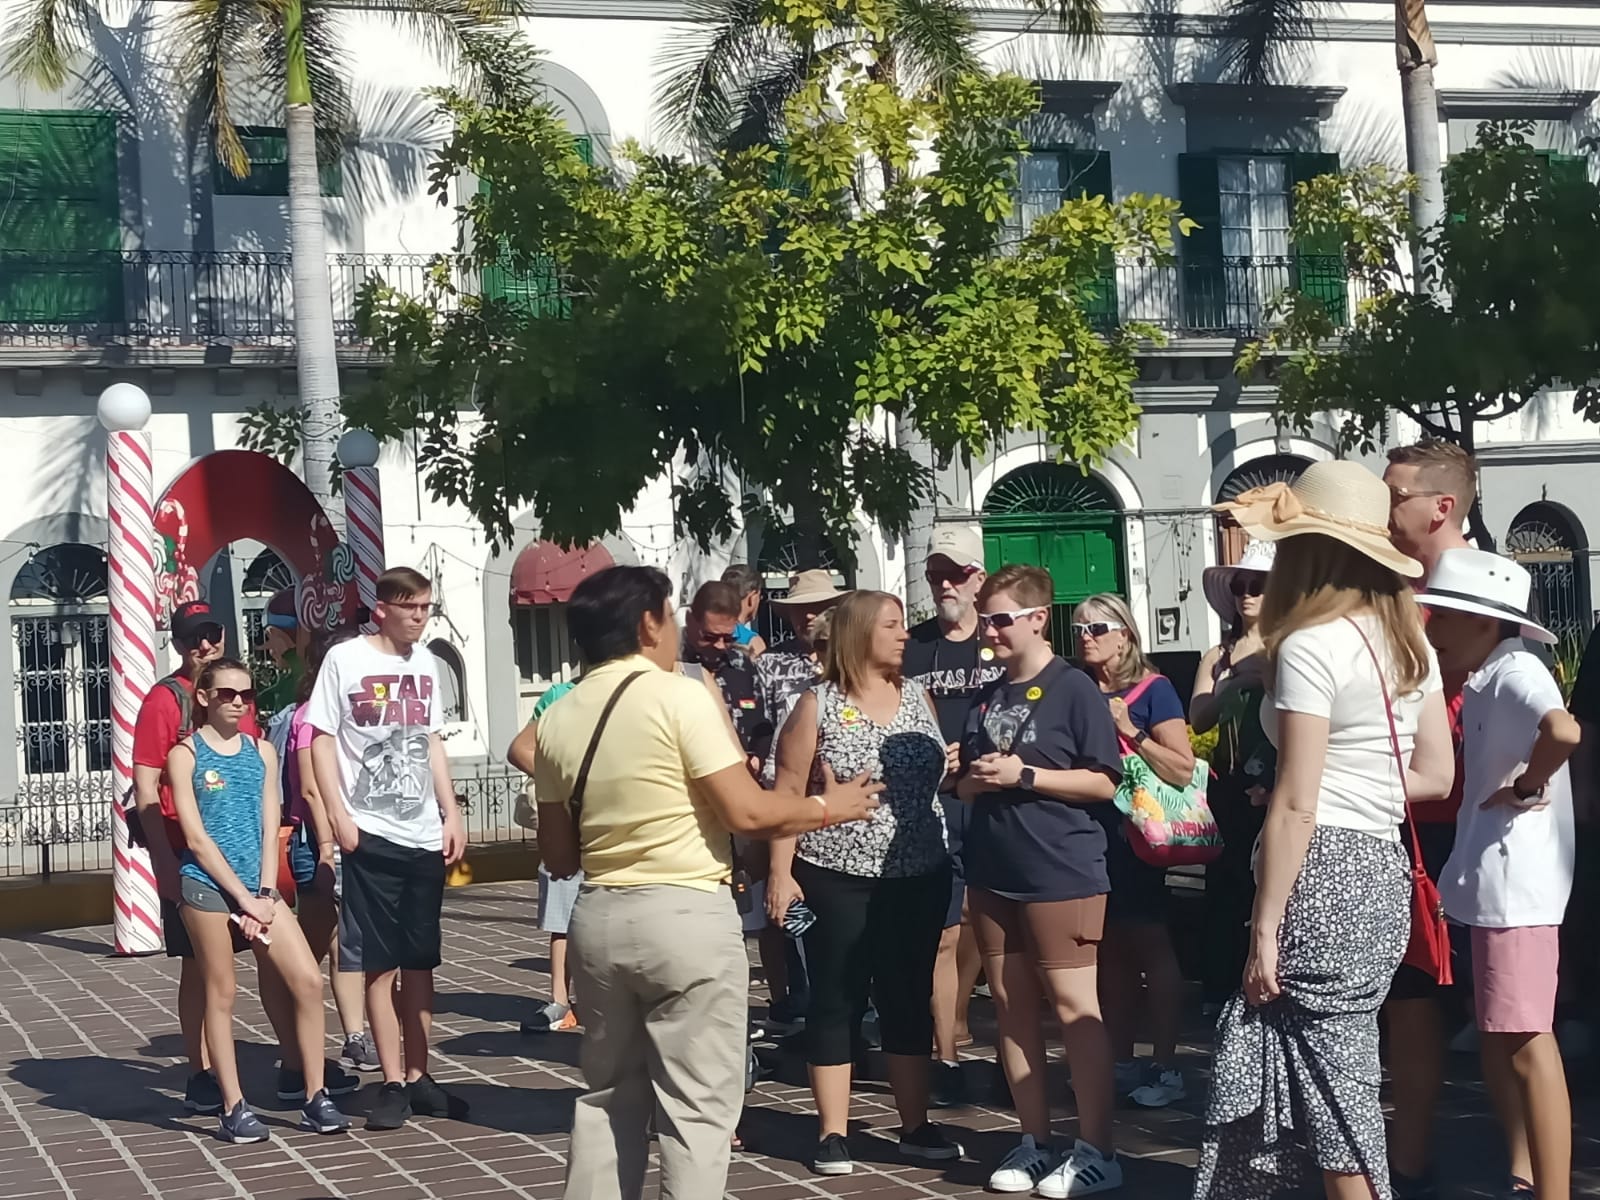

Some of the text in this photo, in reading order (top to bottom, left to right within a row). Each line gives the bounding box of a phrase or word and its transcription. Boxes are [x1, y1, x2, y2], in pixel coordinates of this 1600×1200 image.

[348, 674, 433, 701] STAR
[912, 668, 966, 689] TEXAS
[351, 700, 431, 726] WAR
